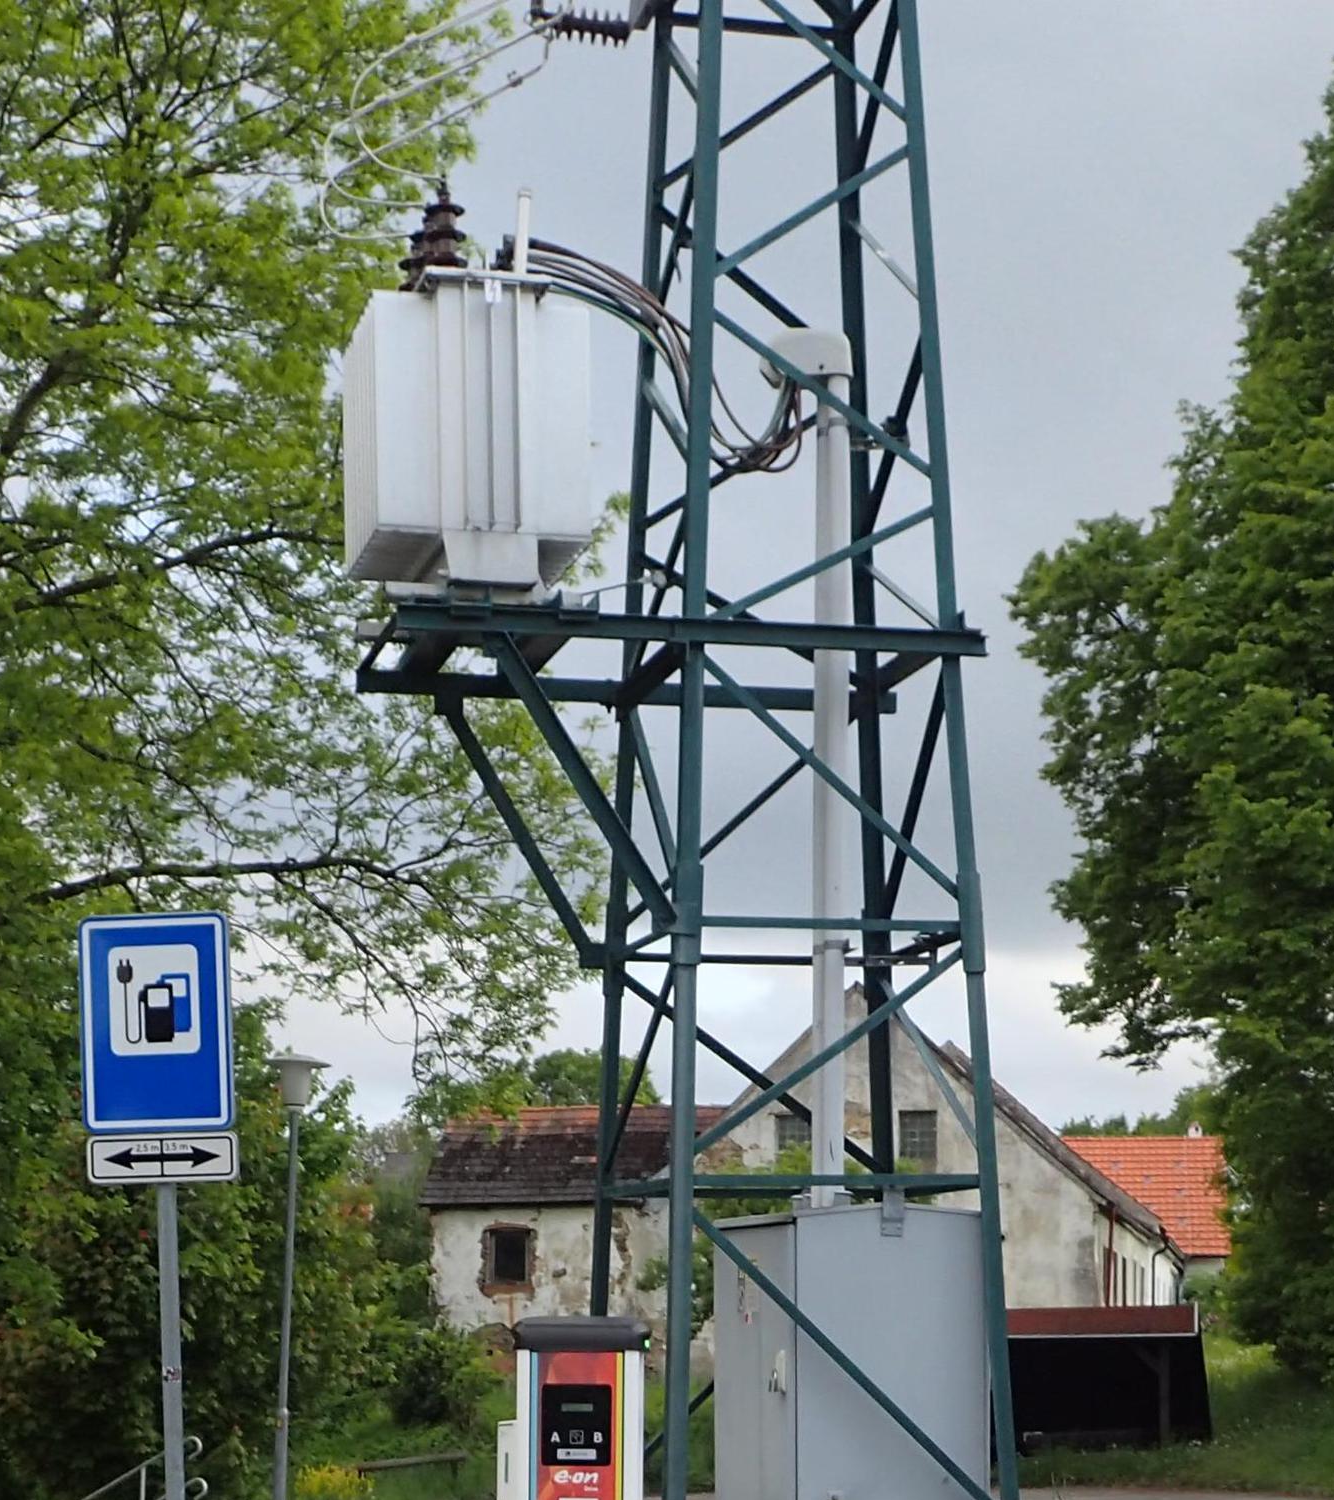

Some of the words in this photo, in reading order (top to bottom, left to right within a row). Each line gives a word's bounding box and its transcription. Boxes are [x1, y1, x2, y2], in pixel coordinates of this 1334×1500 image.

[150, 1144, 160, 1152] m
[550, 1431, 560, 1443] A
[593, 1431, 603, 1443] B
